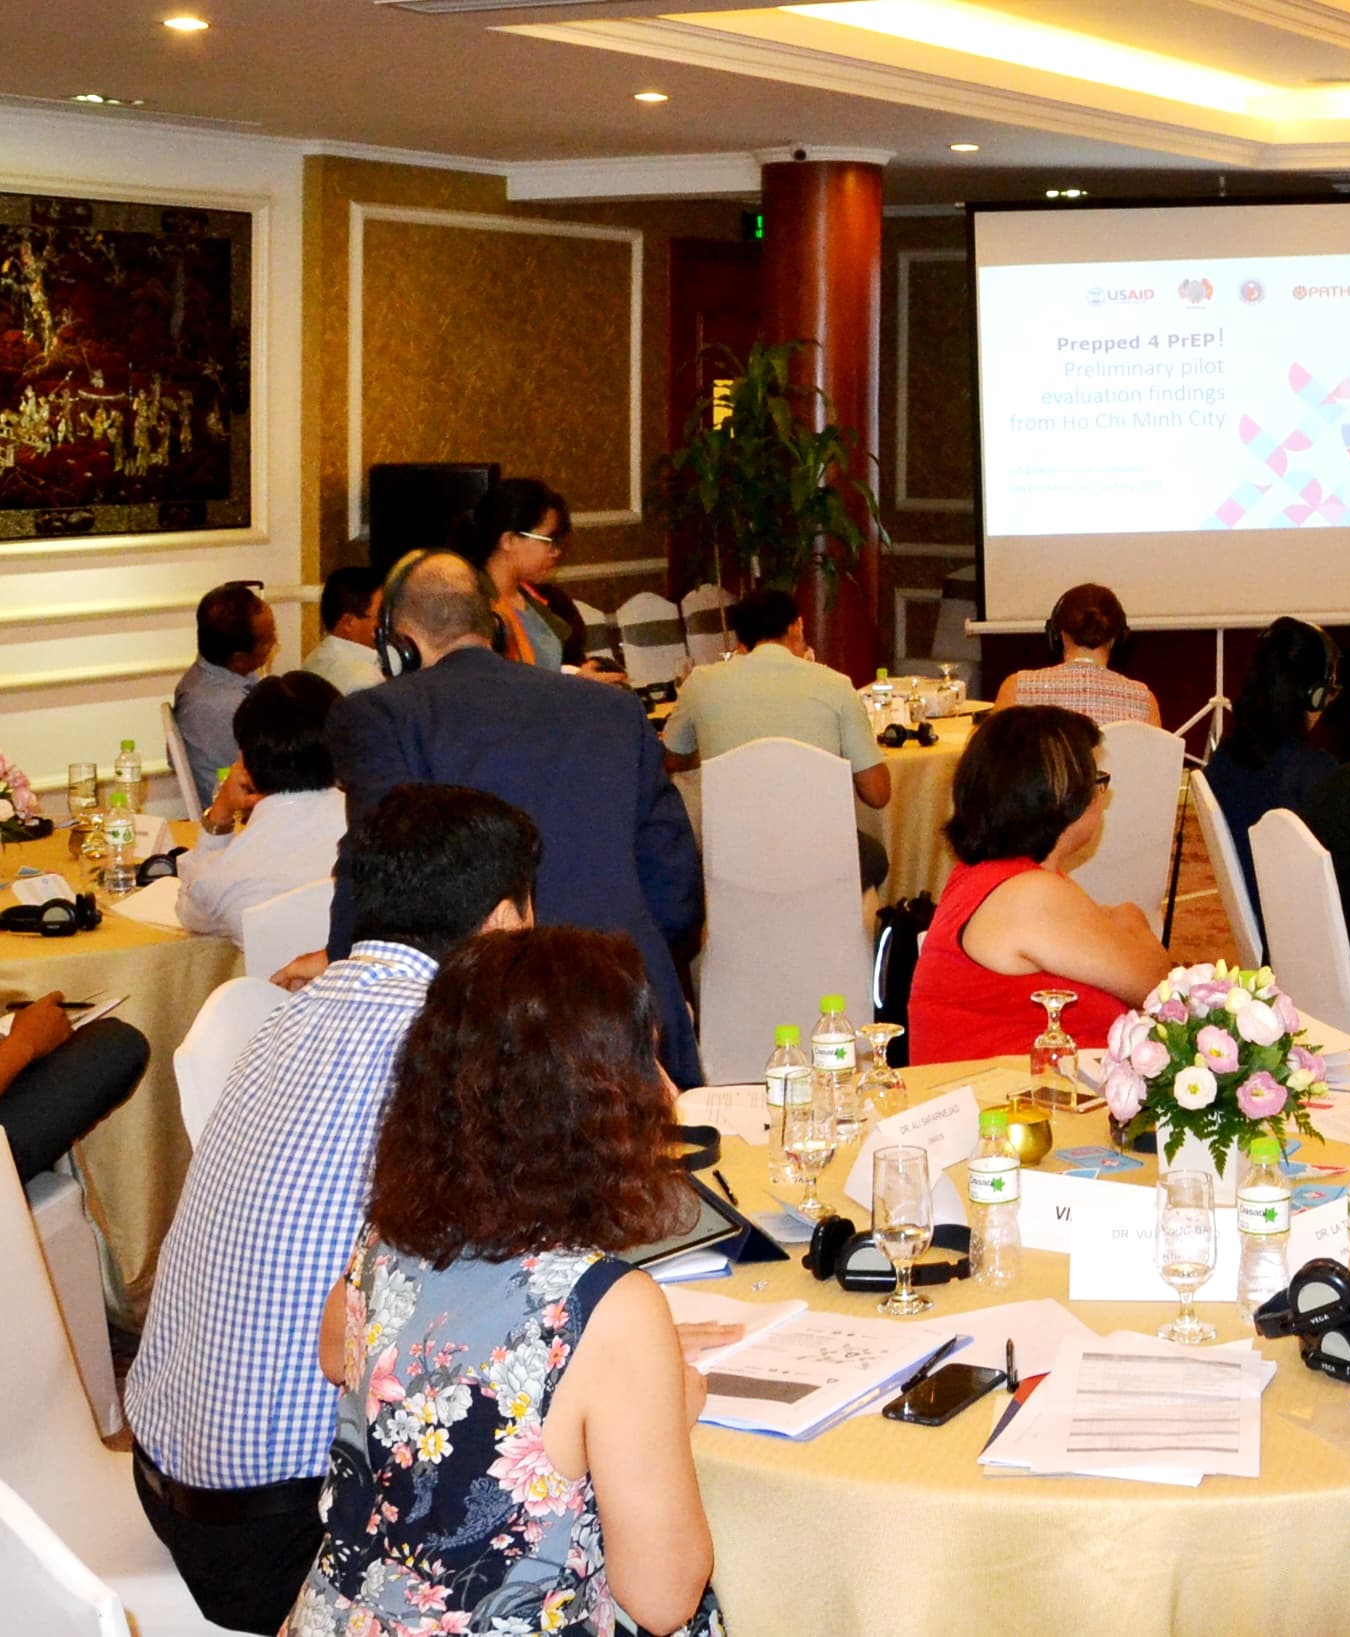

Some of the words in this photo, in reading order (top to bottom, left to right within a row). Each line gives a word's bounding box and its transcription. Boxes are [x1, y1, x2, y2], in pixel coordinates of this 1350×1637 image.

[1108, 288, 1154, 301] USAID
[1308, 286, 1350, 297] PATH
[1057, 336, 1141, 354] Prepped
[1147, 334, 1160, 349] 4
[1064, 359, 1174, 379] Preliminary
[1181, 357, 1225, 378] pilot
[1041, 386, 1142, 405] evaluation
[1150, 383, 1225, 405] findings
[1009, 414, 1056, 432] from
[1063, 414, 1089, 430] Ho
[1096, 411, 1126, 430] Chi
[1132, 409, 1182, 428] Minh
[1189, 409, 1227, 430] City
[1310, 1313, 1330, 1325] VEGA
